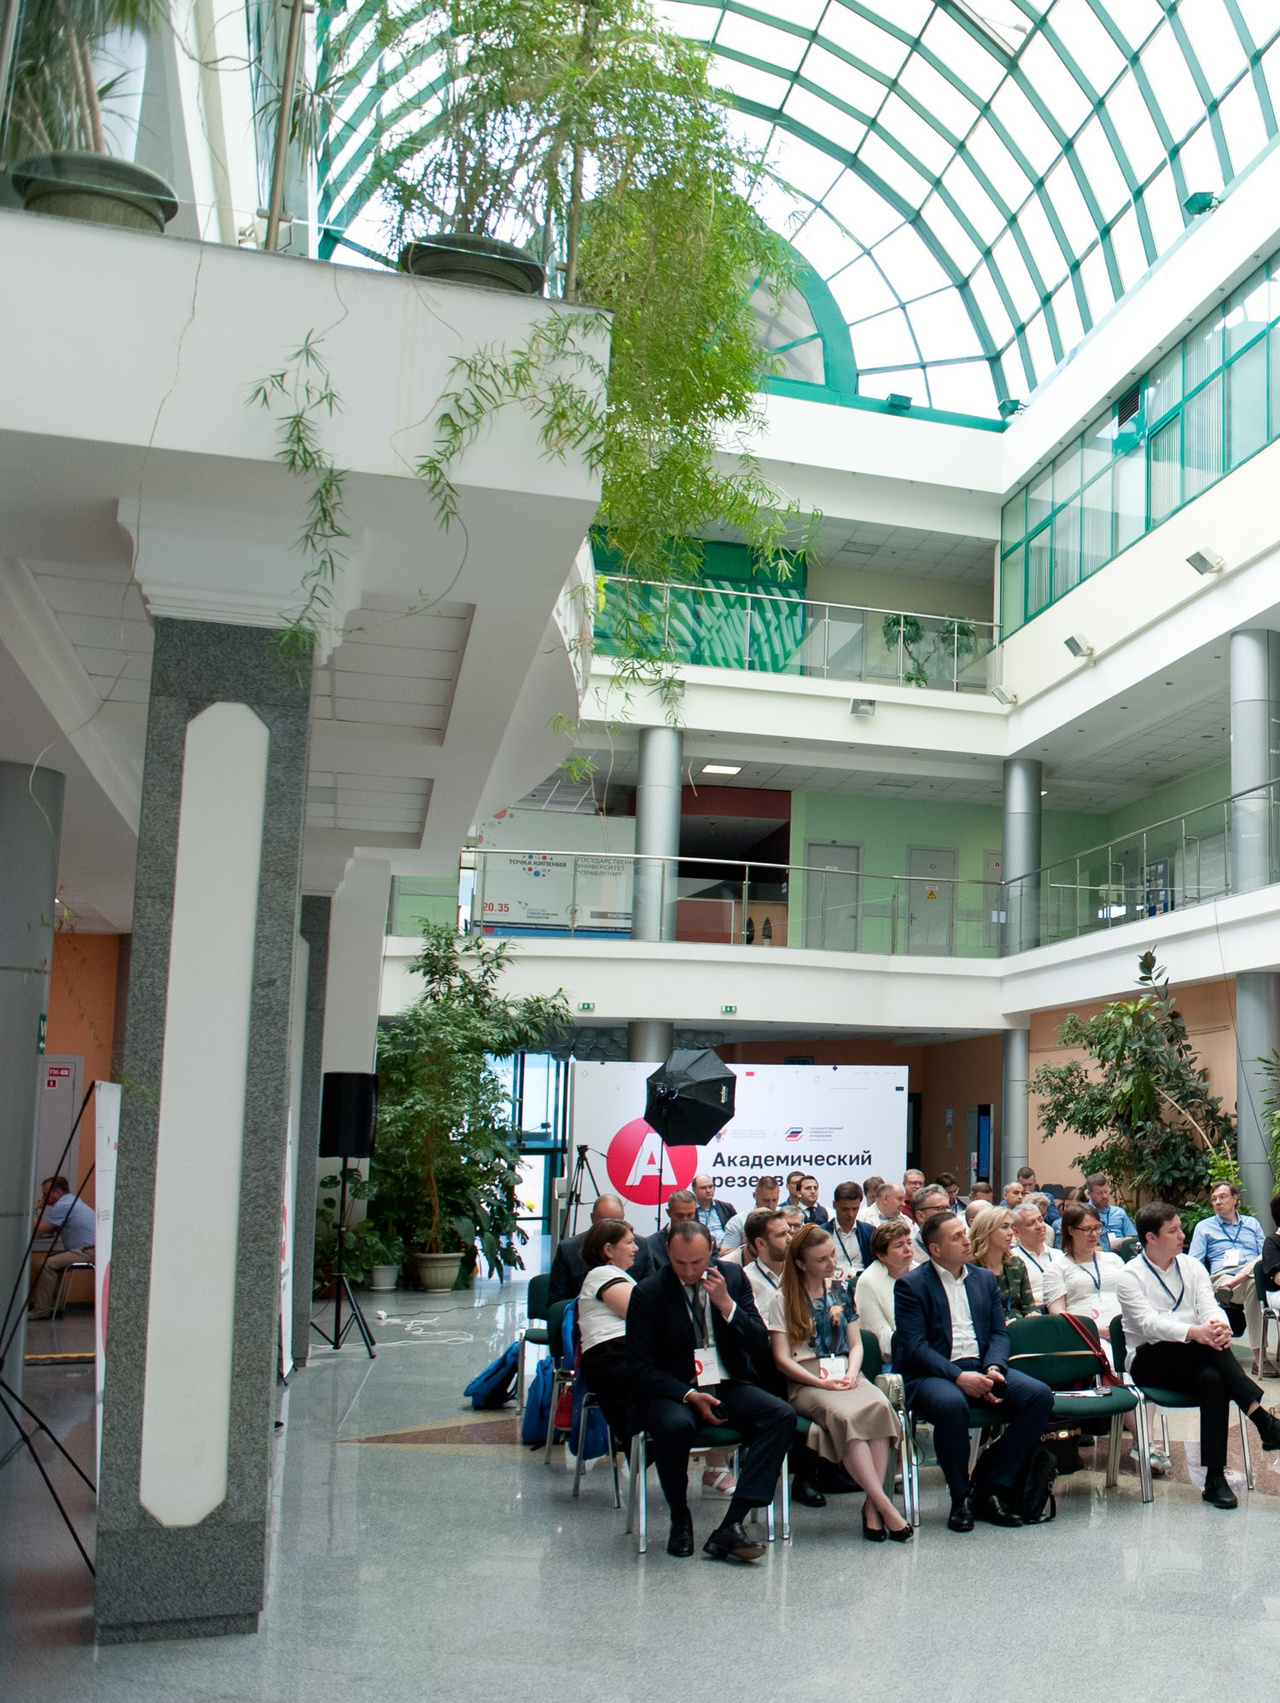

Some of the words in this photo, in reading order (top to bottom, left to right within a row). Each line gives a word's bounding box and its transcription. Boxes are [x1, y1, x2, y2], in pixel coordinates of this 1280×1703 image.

[509, 858, 532, 866] ТОЧКА
[533, 860, 567, 868] КИПЕНИЯ
[577, 857, 635, 866] ГОСУДАРСТВЕНН
[483, 902, 509, 912] 20.35
[712, 1150, 872, 1170] Академический
[713, 1174, 784, 1189] резев
